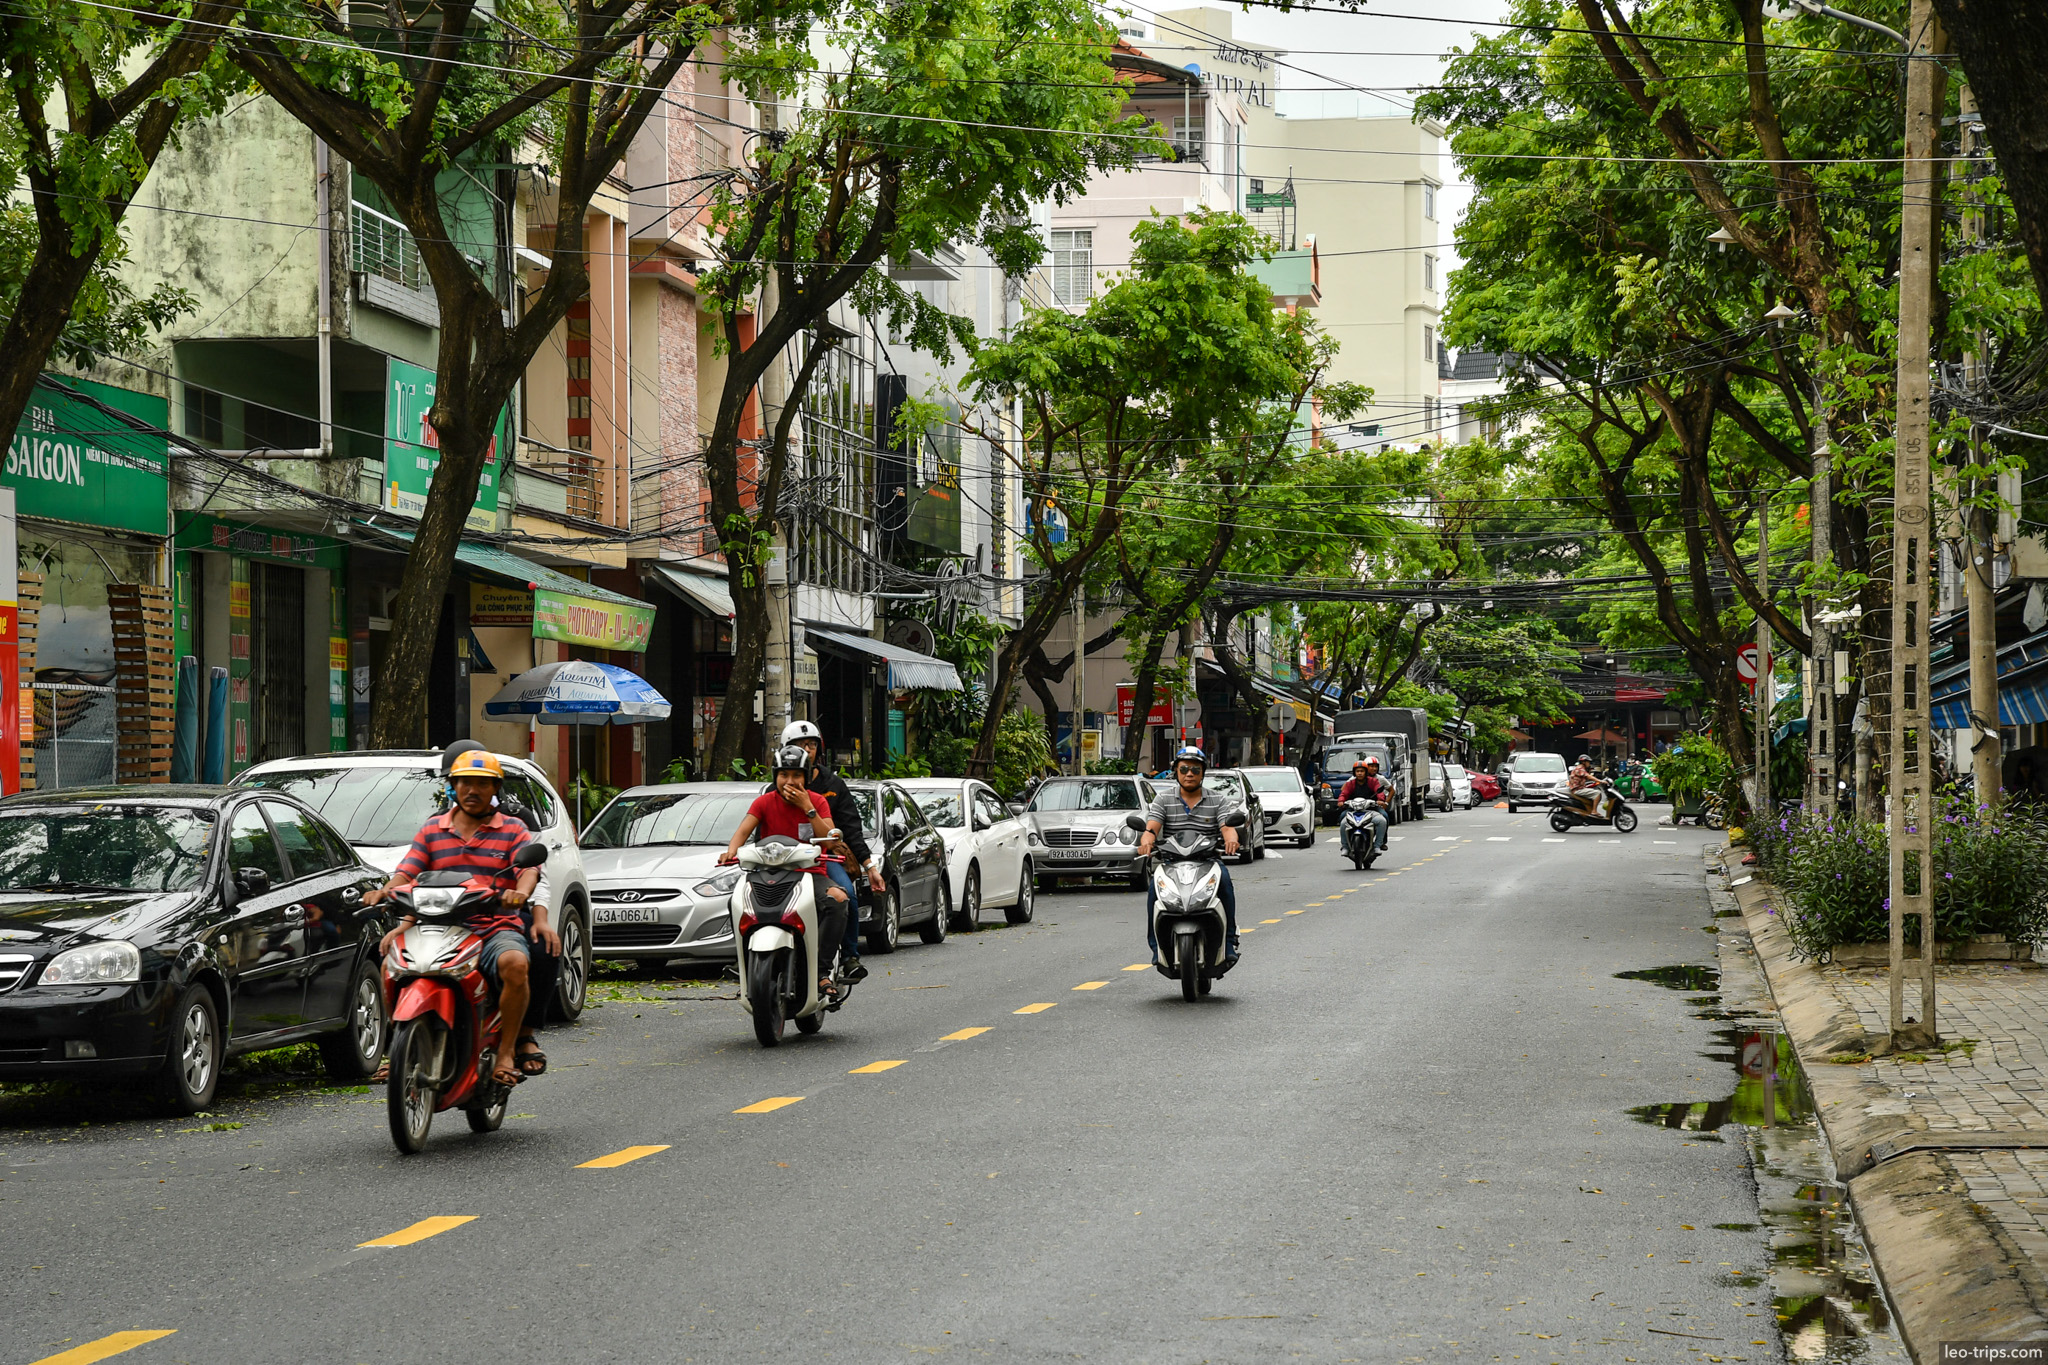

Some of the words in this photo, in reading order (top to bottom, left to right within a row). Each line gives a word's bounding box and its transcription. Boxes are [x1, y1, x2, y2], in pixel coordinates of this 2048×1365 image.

[1200, 70, 1272, 107] ENTRAL
[32, 406, 56, 434] BIA
[6, 434, 80, 486] SAIGON
[213, 524, 229, 548] SCAN
[567, 604, 609, 640] PHOTOCOPY
[614, 613, 622, 642] IN
[517, 685, 562, 701] AQUAFINA
[554, 670, 607, 689] AQUAFINA
[234, 719, 247, 763] A4
[597, 909, 655, 922] 43A-066.41
